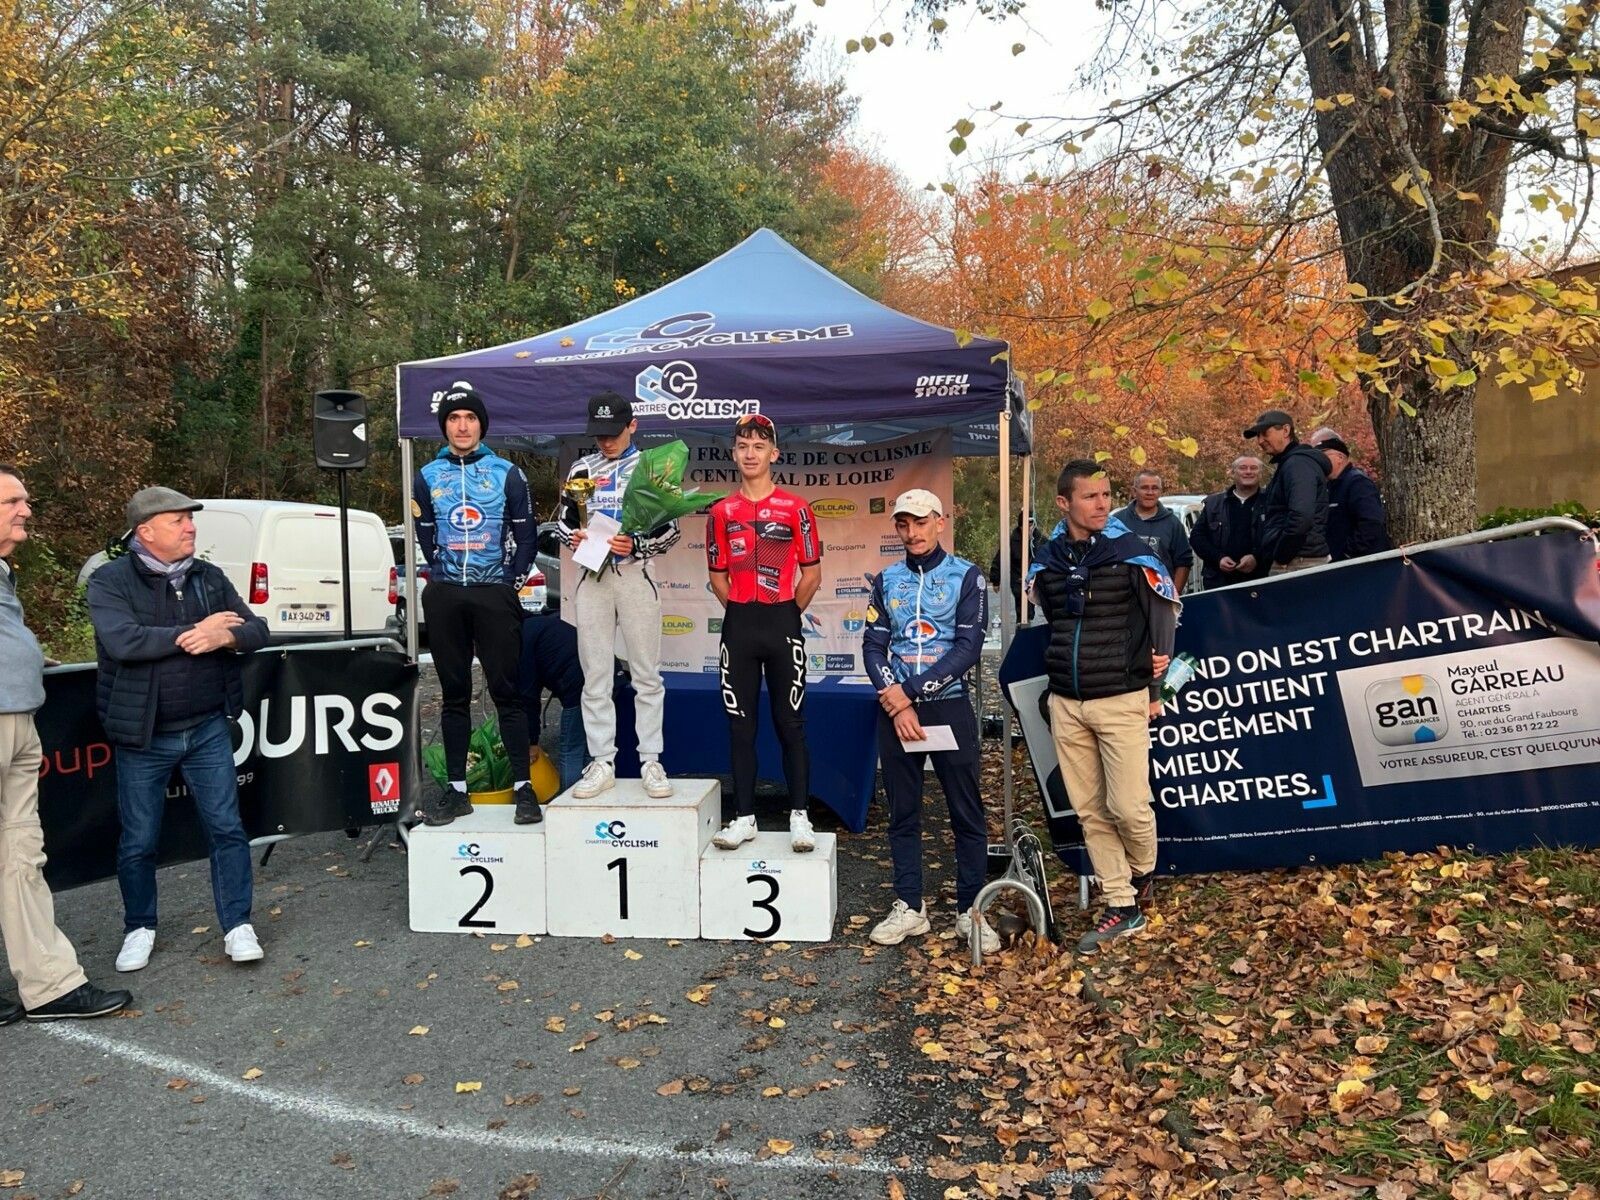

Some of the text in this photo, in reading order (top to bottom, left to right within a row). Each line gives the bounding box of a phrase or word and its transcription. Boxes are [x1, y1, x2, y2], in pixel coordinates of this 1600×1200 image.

[650, 325, 851, 353] CYCLISME
[916, 374, 969, 387] DIFFU
[915, 384, 970, 398] SPORT
[633, 402, 757, 416] ARTRES CYCLISME
[803, 452, 828, 466] DE
[833, 441, 933, 465] CYCLISME
[805, 474, 829, 487] DE
[836, 468, 895, 486] LOIRE
[826, 543, 866, 552] Groupama
[662, 621, 694, 629] LOLAND
[1236, 646, 1281, 674] ON
[1288, 636, 1341, 667] EST
[1447, 659, 1499, 678] Mayeul
[1451, 664, 1564, 695] GARREAU
[1186, 672, 1328, 713] SOUTIENT
[1455, 696, 1486, 707] AGENT
[1488, 690, 1531, 702] GÉNÉRAL
[1376, 695, 1438, 728] gan
[1457, 704, 1511, 717] CHARTRES
[1478, 719, 1492, 727] rue
[1493, 716, 1505, 725] du
[1506, 713, 1534, 723] Grand
[1535, 708, 1578, 719] Faubourg
[1148, 706, 1315, 749] FORCÉMENT
[1401, 716, 1441, 726] ASSURANCES
[1485, 727, 1499, 736] 02
[1502, 724, 1514, 733] 36
[1516, 723, 1528, 732] 81
[1530, 722, 1544, 730] 22
[1545, 720, 1559, 729] 22
[1152, 748, 1244, 779] MIEUX
[1379, 757, 1418, 769] VOTRE
[1421, 750, 1488, 766] ASSUREUR,
[1490, 745, 1524, 758] C'EST
[1160, 772, 1318, 808] CHARTRES.
[371, 799, 400, 808] RENAULT
[372, 806, 399, 815] TRUCKS
[611, 839, 659, 848] CYCLISME
[458, 865, 496, 928] 2
[607, 857, 629, 920] 1
[742, 873, 781, 939] 3
